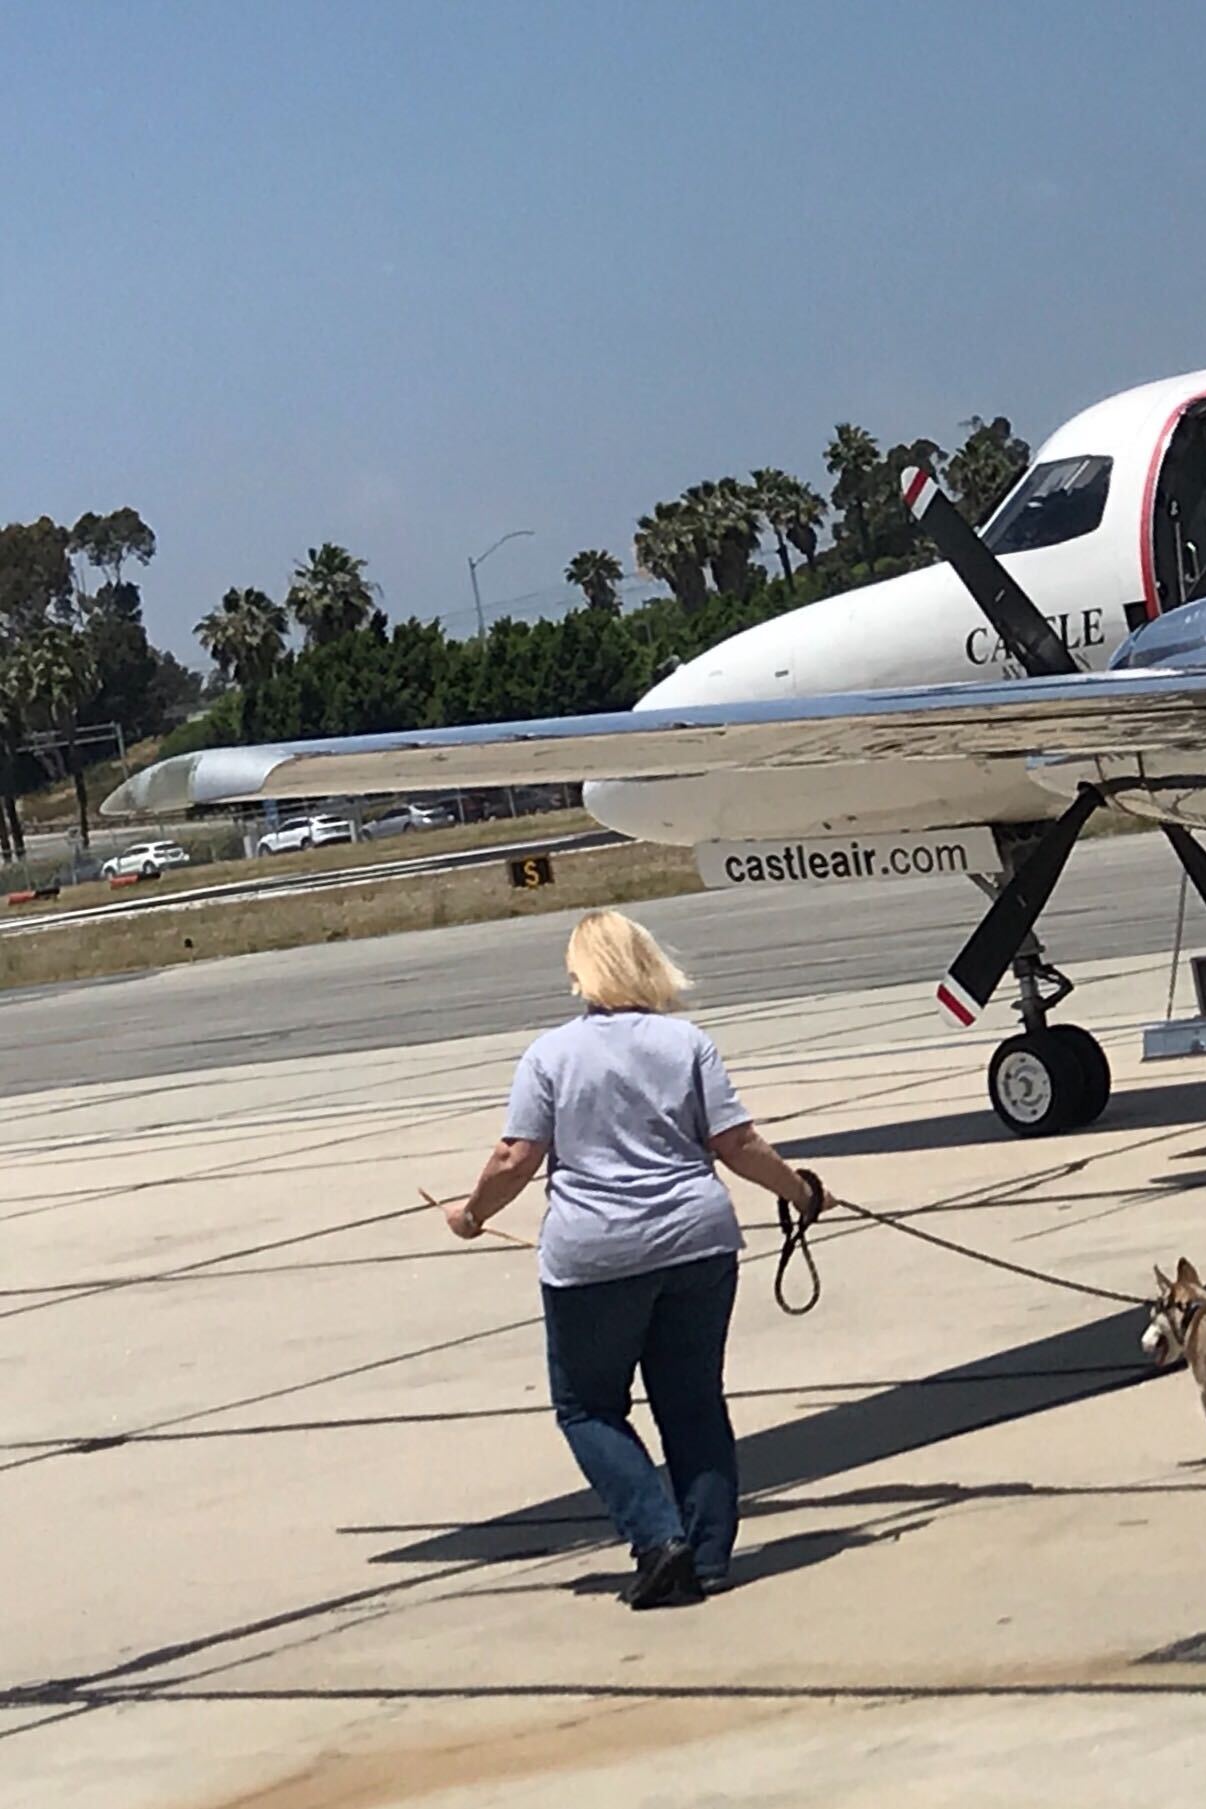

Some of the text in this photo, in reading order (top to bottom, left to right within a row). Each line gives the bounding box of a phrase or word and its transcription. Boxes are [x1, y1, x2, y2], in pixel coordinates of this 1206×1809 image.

[965, 607, 1105, 665] CALE
[523, 859, 541, 887] S
[724, 841, 969, 883] castleair.com
